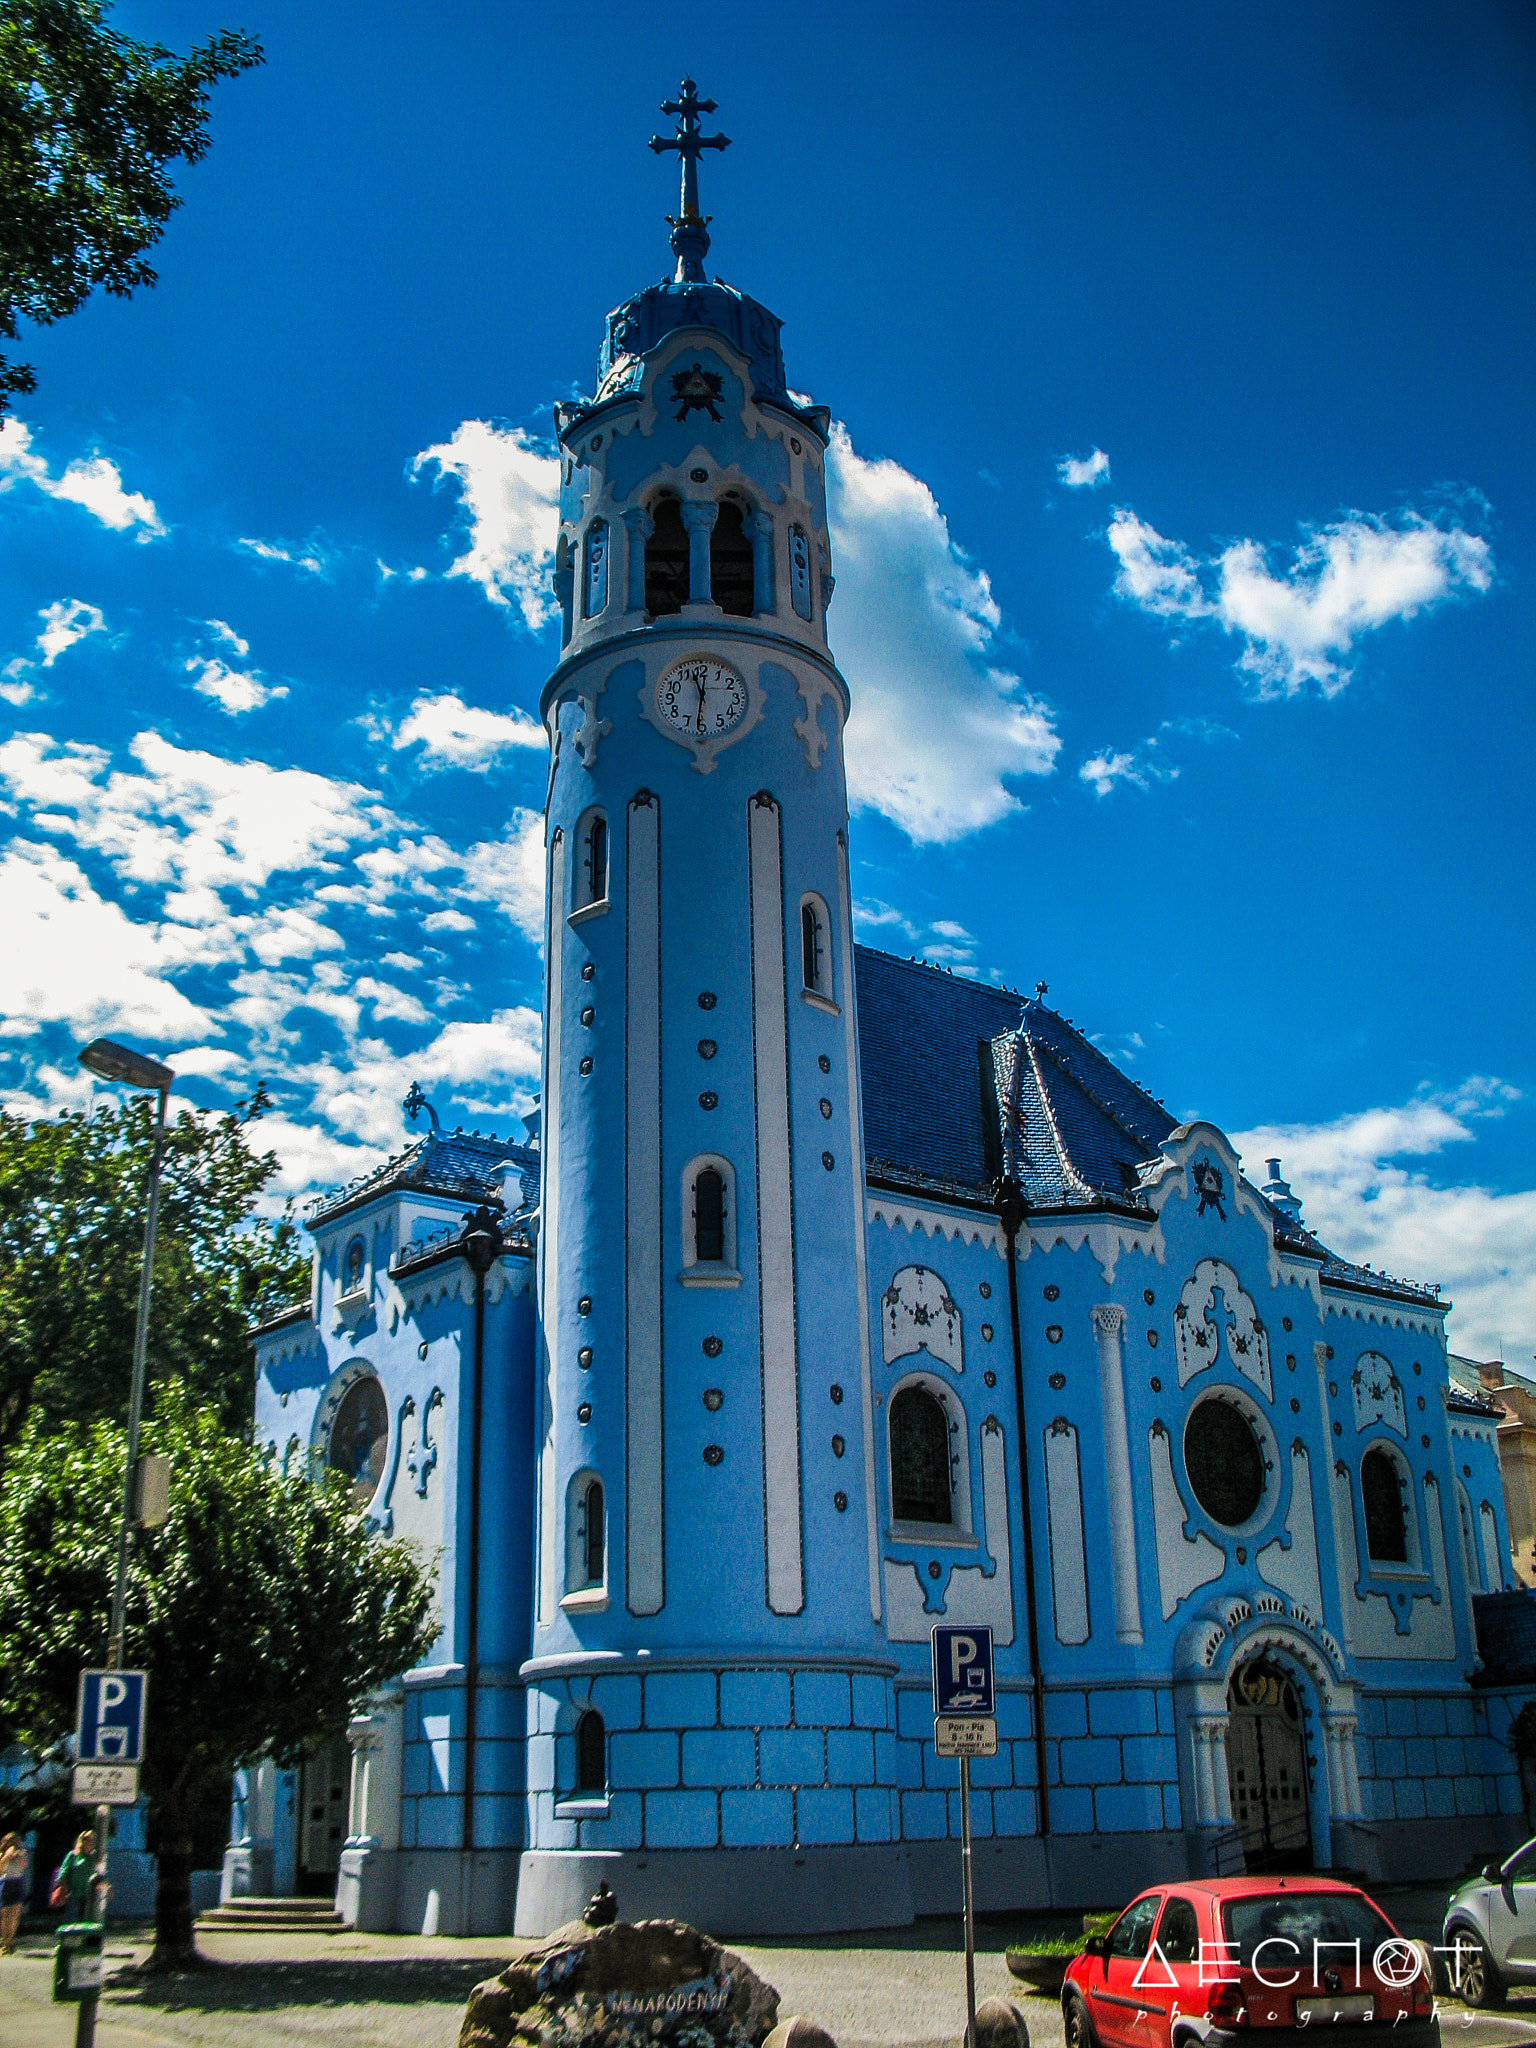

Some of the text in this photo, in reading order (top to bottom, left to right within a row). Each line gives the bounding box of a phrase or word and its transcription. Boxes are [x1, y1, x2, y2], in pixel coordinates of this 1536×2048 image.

[678, 668, 690, 681] 11
[693, 664, 708, 678] 12
[715, 670, 721, 681] 1
[668, 680, 681, 694] 10
[726, 678, 734, 690] 2
[665, 693, 675, 705] 9
[732, 693, 740, 705] 3
[670, 705, 678, 718] 8
[727, 705, 736, 719] 4
[683, 715, 692, 726] 7
[716, 714, 724, 727] 5
[952, 1636, 977, 1682] P
[97, 1676, 127, 1725] P
[948, 1722, 965, 1732] Pon
